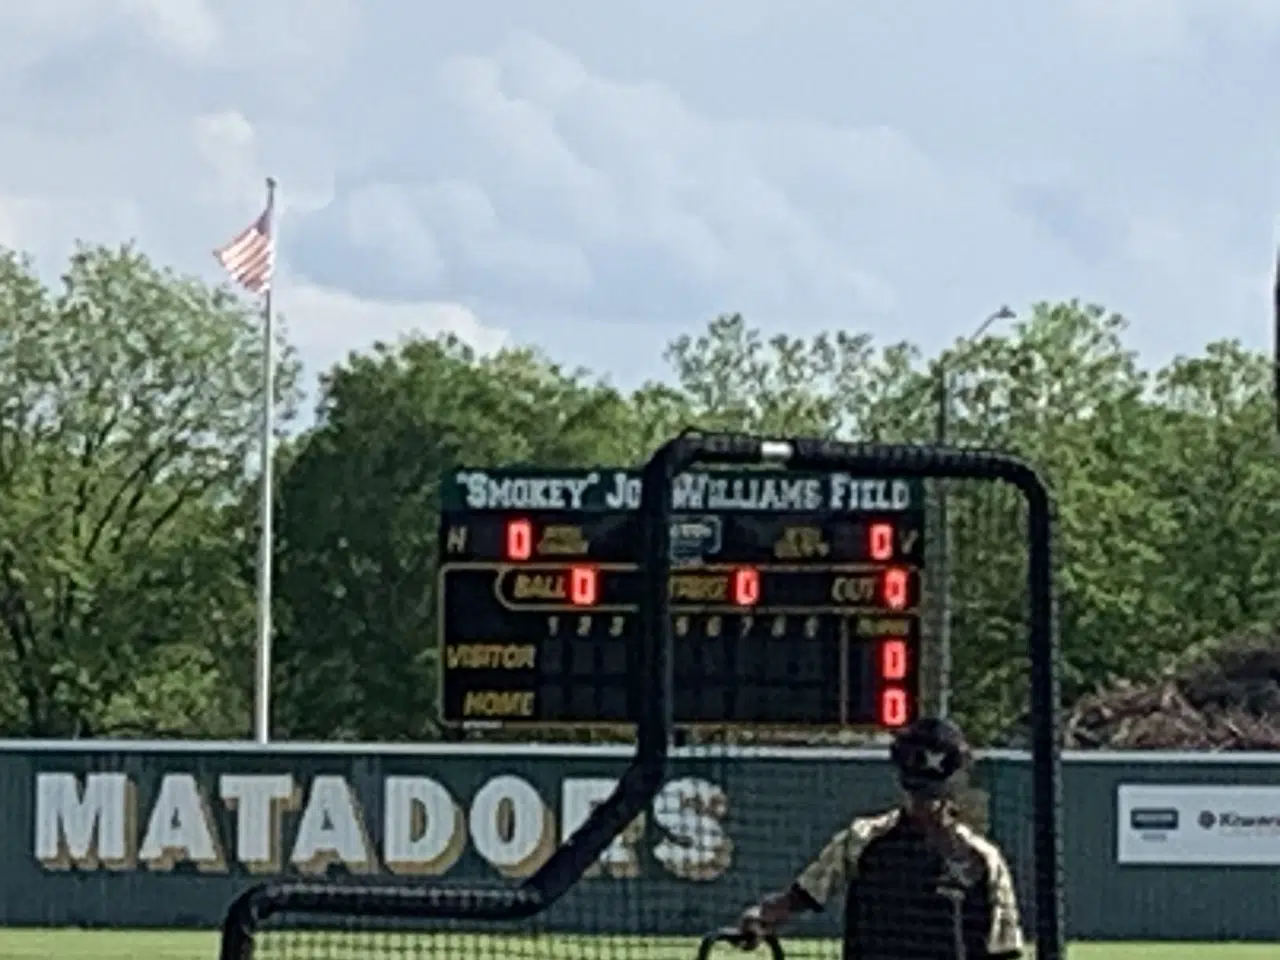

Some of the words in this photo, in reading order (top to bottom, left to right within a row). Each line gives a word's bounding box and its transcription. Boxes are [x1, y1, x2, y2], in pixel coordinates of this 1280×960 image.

[456, 472, 600, 509] "SMOKEY"
[606, 473, 643, 509] JO
[672, 472, 822, 510] WILLIAMS
[829, 472, 910, 510] FIELD
[508, 520, 531, 560] 0
[871, 523, 893, 560] 0
[513, 573, 566, 599] BALL
[572, 567, 596, 605] 0
[735, 567, 760, 605] 0
[884, 569, 908, 609] 0
[548, 615, 560, 637] 1
[576, 615, 593, 637] 2
[447, 643, 536, 669] VISITOR
[883, 641, 906, 681] 0
[463, 691, 536, 717] HOME
[883, 688, 906, 727] 0
